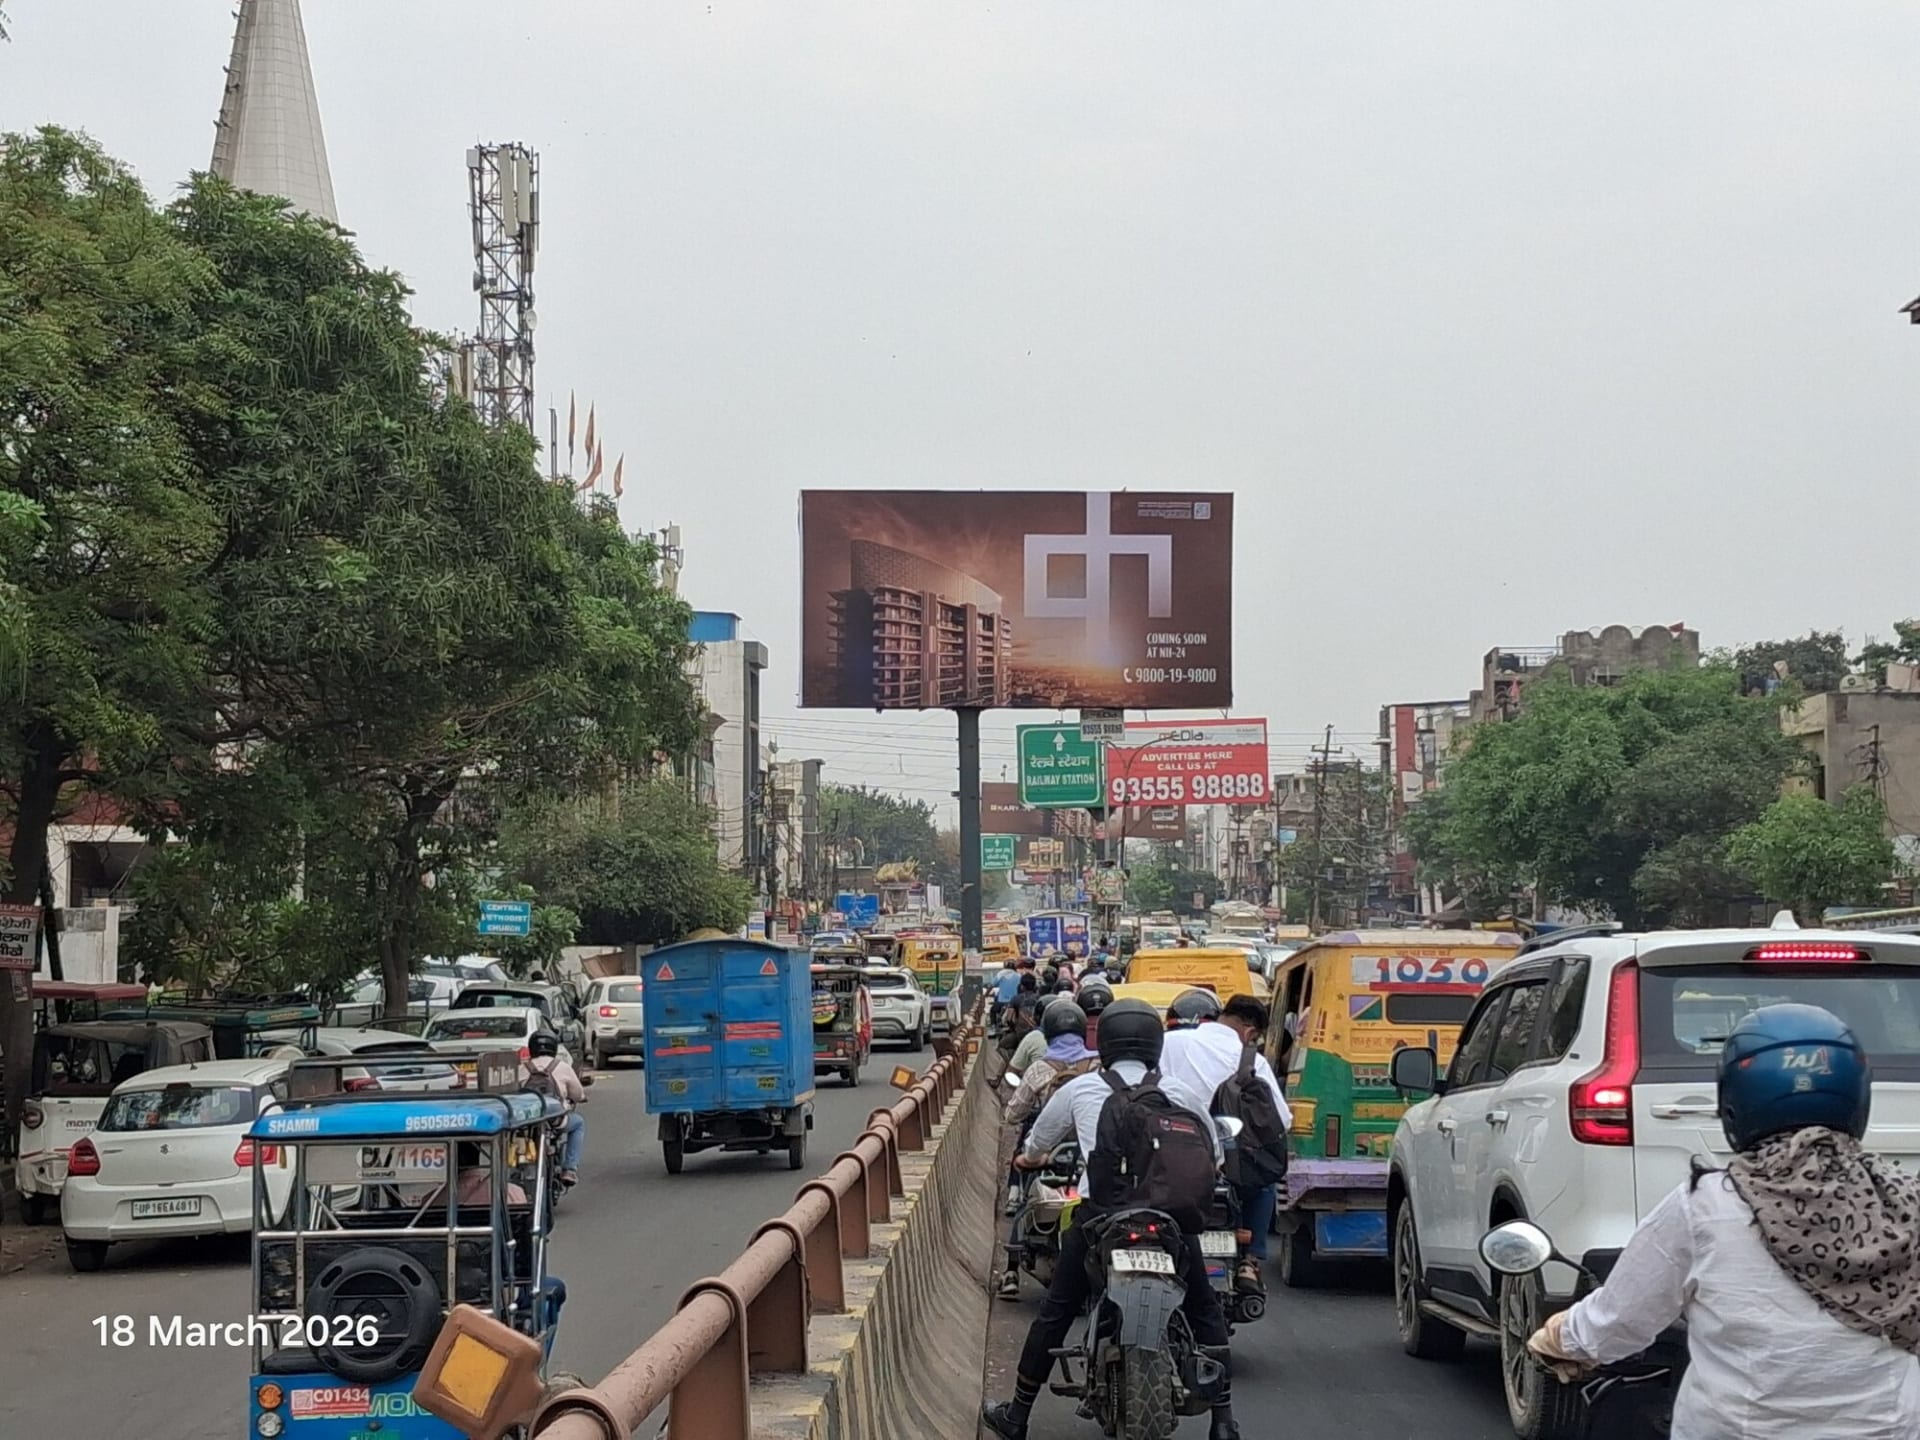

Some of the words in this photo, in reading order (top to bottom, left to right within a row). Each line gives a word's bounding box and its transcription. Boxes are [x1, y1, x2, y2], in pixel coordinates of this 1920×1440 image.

[1146, 633, 1181, 645] COMING
[1183, 633, 1207, 645] SOON
[1146, 647, 1158, 658] AT
[1135, 668, 1217, 683] 9800-19-9800
[1141, 752, 1201, 762] ADVERTISE
[1204, 751, 1233, 760] HERE
[1157, 763, 1184, 771] CALL
[1186, 762, 1201, 770] US
[1203, 761, 1217, 770] AT
[1026, 775, 1060, 786] RAILWAY
[1061, 773, 1094, 785] STATION
[1112, 776, 1184, 802] 93555
[1192, 773, 1264, 799] 98888
[1377, 958, 1489, 983] 1050
[269, 1117, 320, 1133] SHAMMI
[405, 1114, 478, 1131] 9650582637
[313, 1388, 370, 1403] C01434
